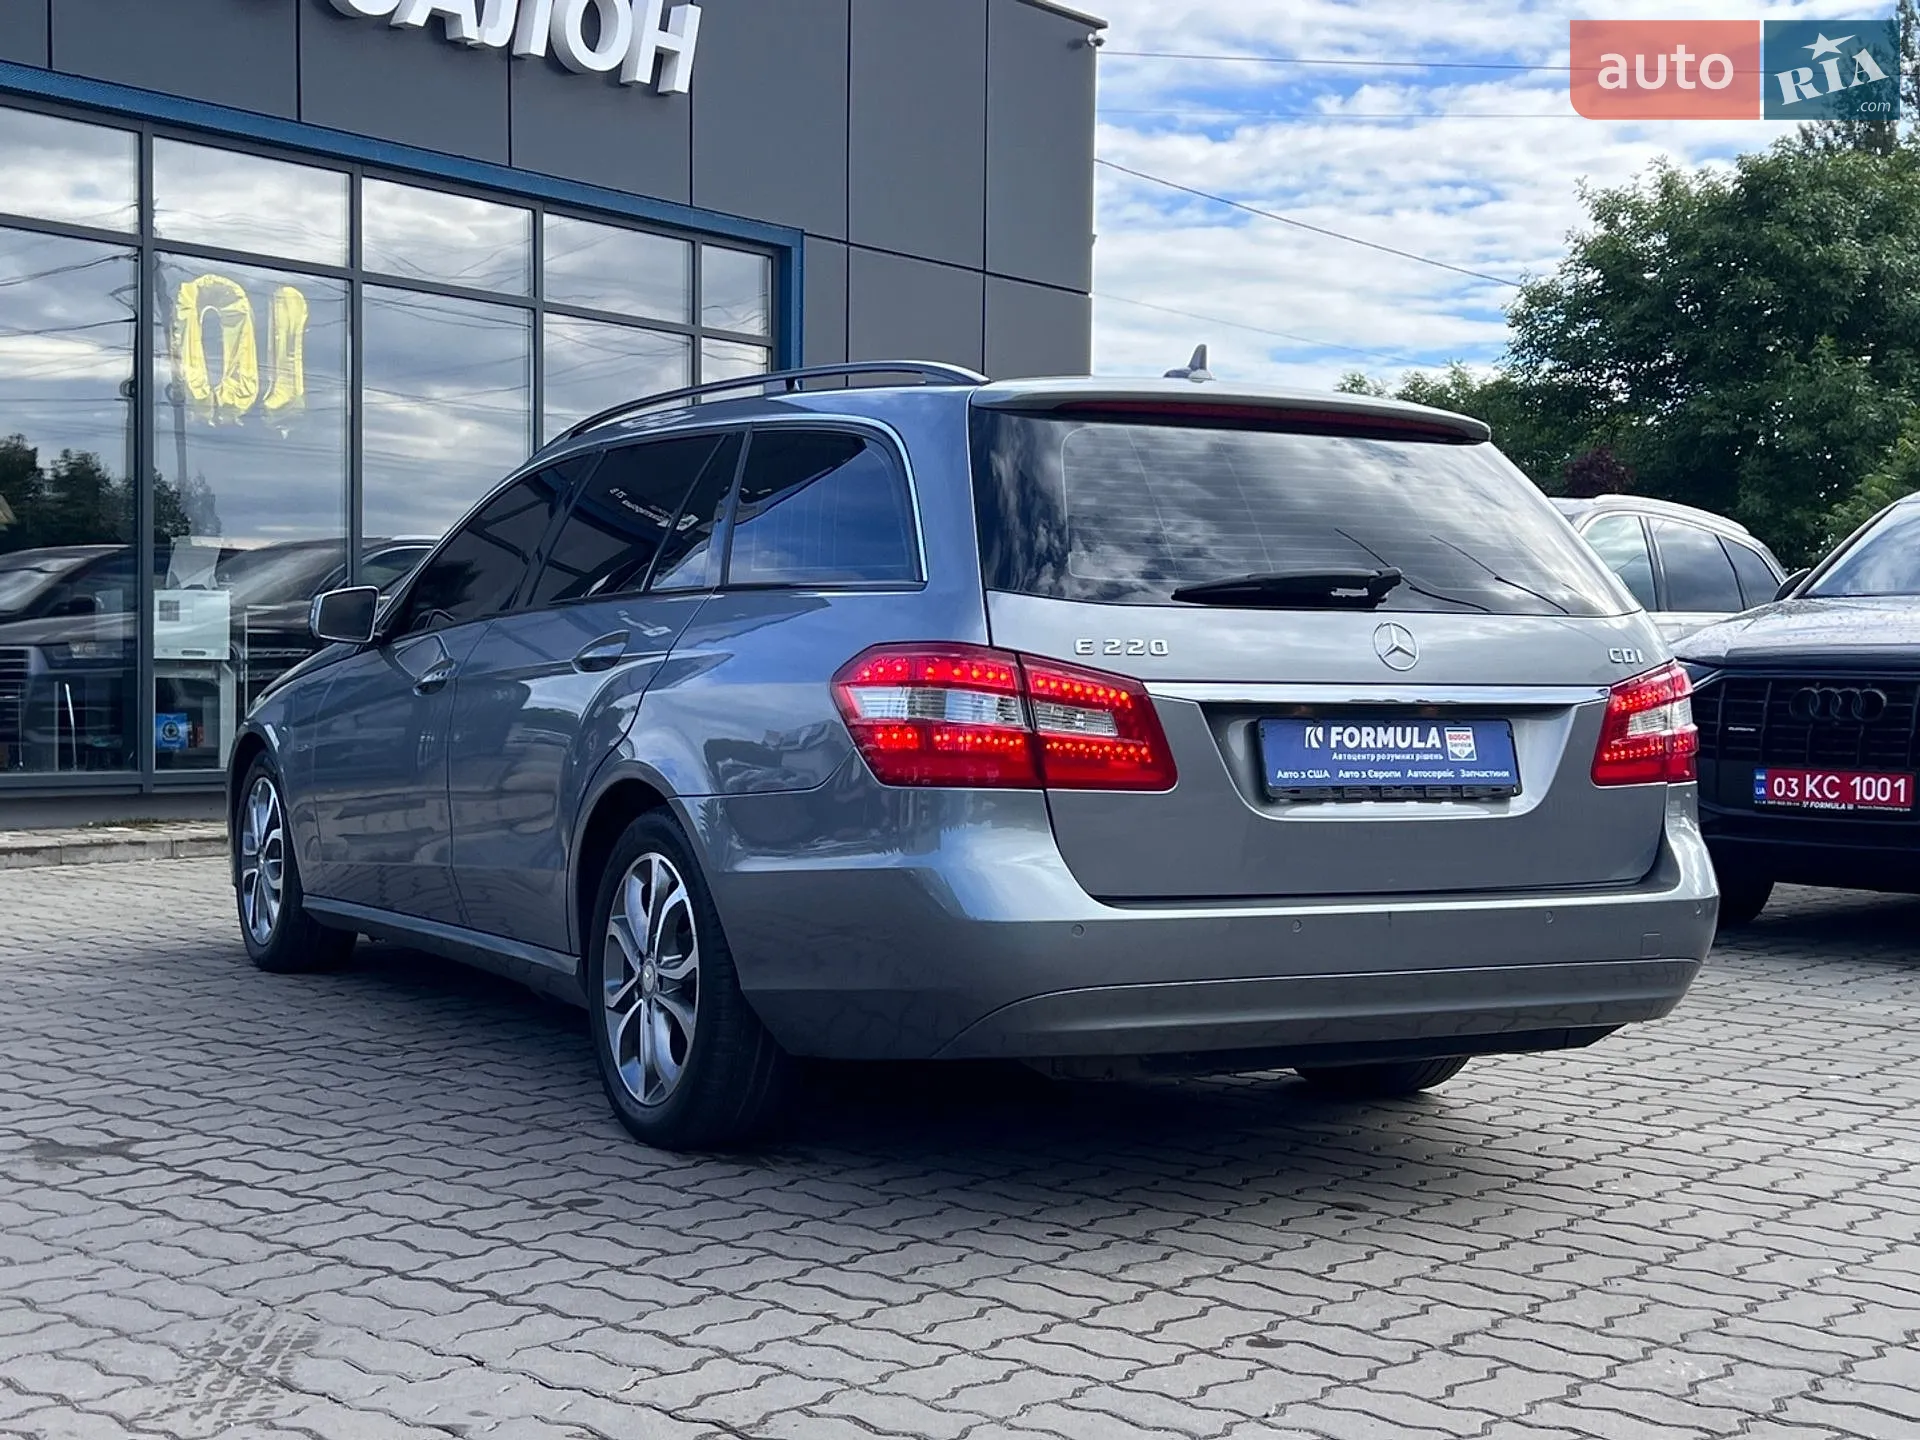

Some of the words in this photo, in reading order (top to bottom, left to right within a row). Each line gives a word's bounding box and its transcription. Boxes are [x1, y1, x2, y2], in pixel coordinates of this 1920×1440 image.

[327, 0, 702, 95] ЛОН
[1075, 638, 1095, 656] E
[1103, 638, 1169, 657] 220
[1608, 647, 1644, 664] CDI
[1330, 726, 1442, 749] FORMULA
[1332, 752, 1375, 762] Автоцентр
[1277, 769, 1299, 779] Авто
[1307, 769, 1330, 779] США
[1338, 769, 1359, 779] Авто
[1367, 769, 1401, 780] Європи
[1407, 768, 1455, 780] Автосервіс
[1755, 786, 1766, 795] UA
[1773, 777, 1799, 798] 03
[1805, 774, 1841, 799] KC
[1850, 776, 1906, 803] 1001
[1809, 801, 1846, 810] FORMULA
